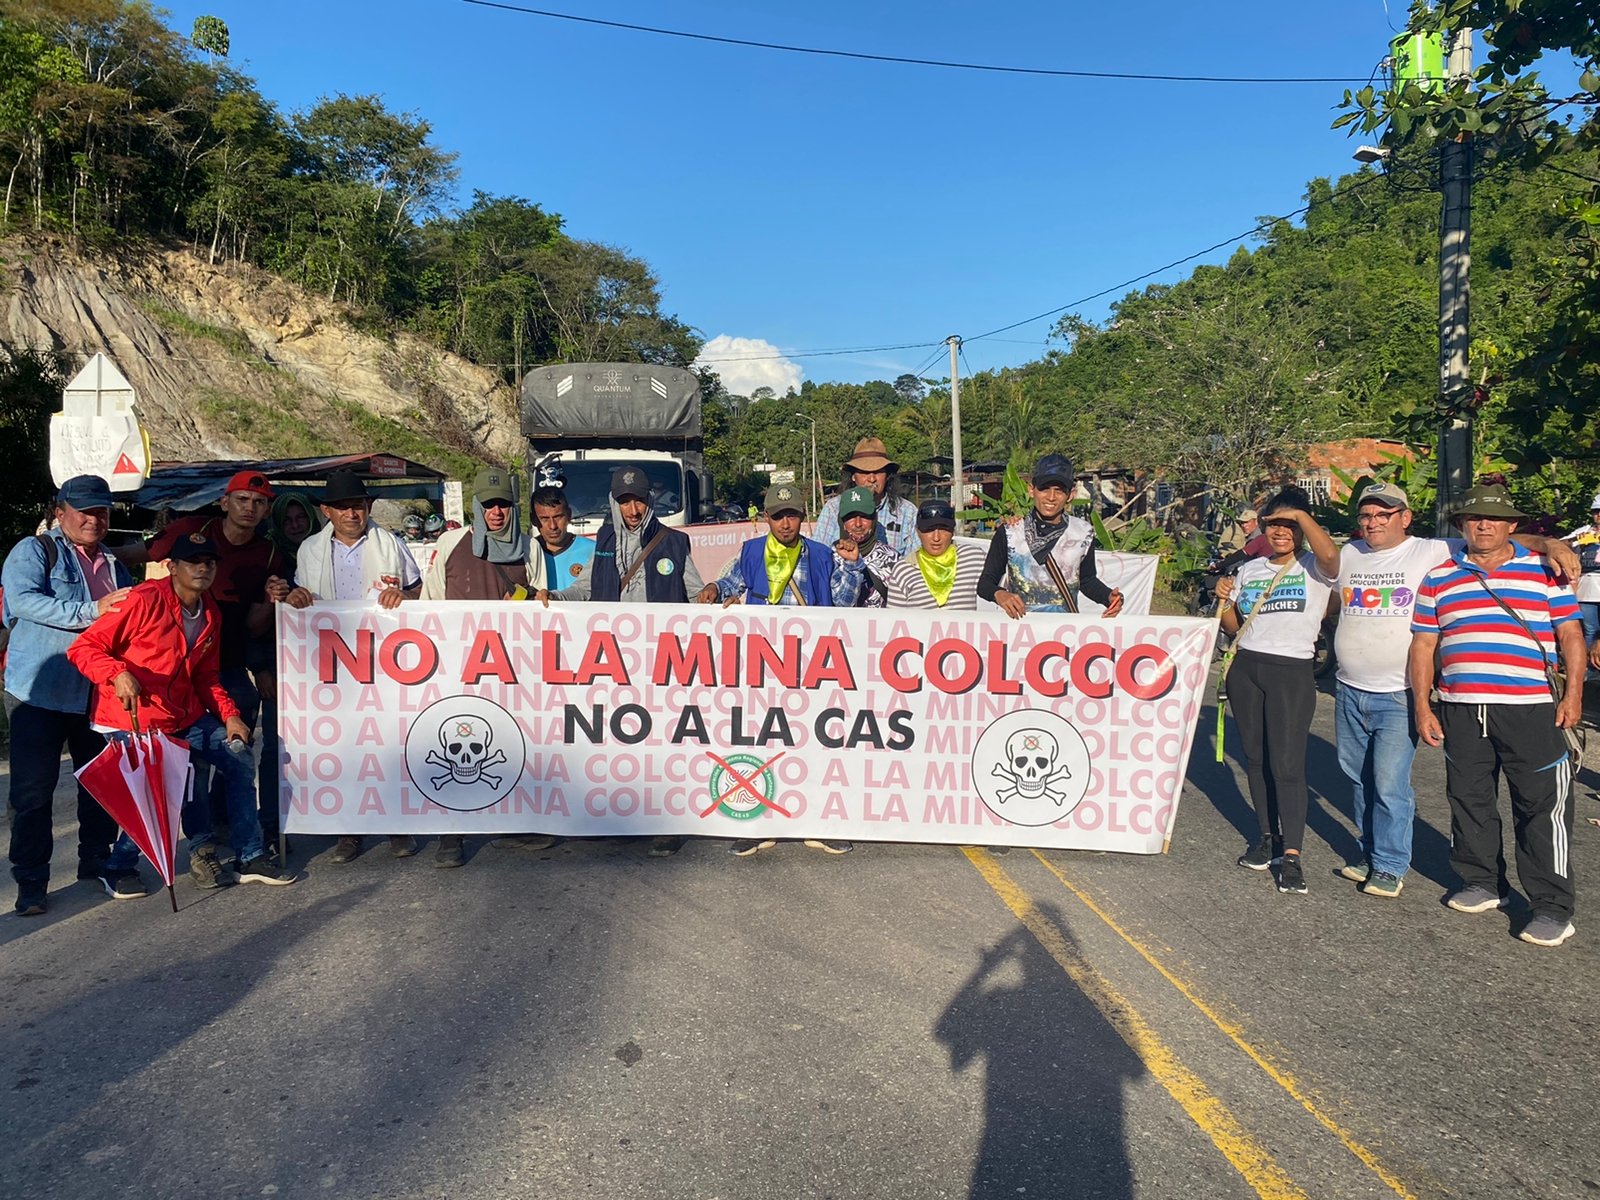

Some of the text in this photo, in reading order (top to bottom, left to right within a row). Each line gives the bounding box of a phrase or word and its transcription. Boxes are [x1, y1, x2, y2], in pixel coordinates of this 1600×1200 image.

[851, 491, 861, 502] LA
[1260, 601, 1298, 612] WILCHES
[1343, 587, 1414, 608] PACTO
[319, 628, 439, 686] NO
[460, 629, 519, 685] A
[542, 630, 631, 686] LA
[652, 631, 857, 691] MINA
[879, 636, 1177, 701] COLCCO
[282, 682, 342, 712] NO
[356, 683, 384, 712] A
[281, 716, 342, 746] NO
[355, 716, 384, 746] A
[564, 703, 652, 745] NO
[671, 705, 710, 746] A
[731, 707, 795, 747] LA
[814, 708, 915, 751] CAS
[281, 752, 343, 783] NO
[357, 752, 386, 782] A
[822, 758, 849, 787] A
[864, 759, 910, 789] LA
[281, 785, 344, 815] NO
[358, 786, 387, 816] A
[821, 792, 849, 820] A
[863, 793, 909, 823] LA
